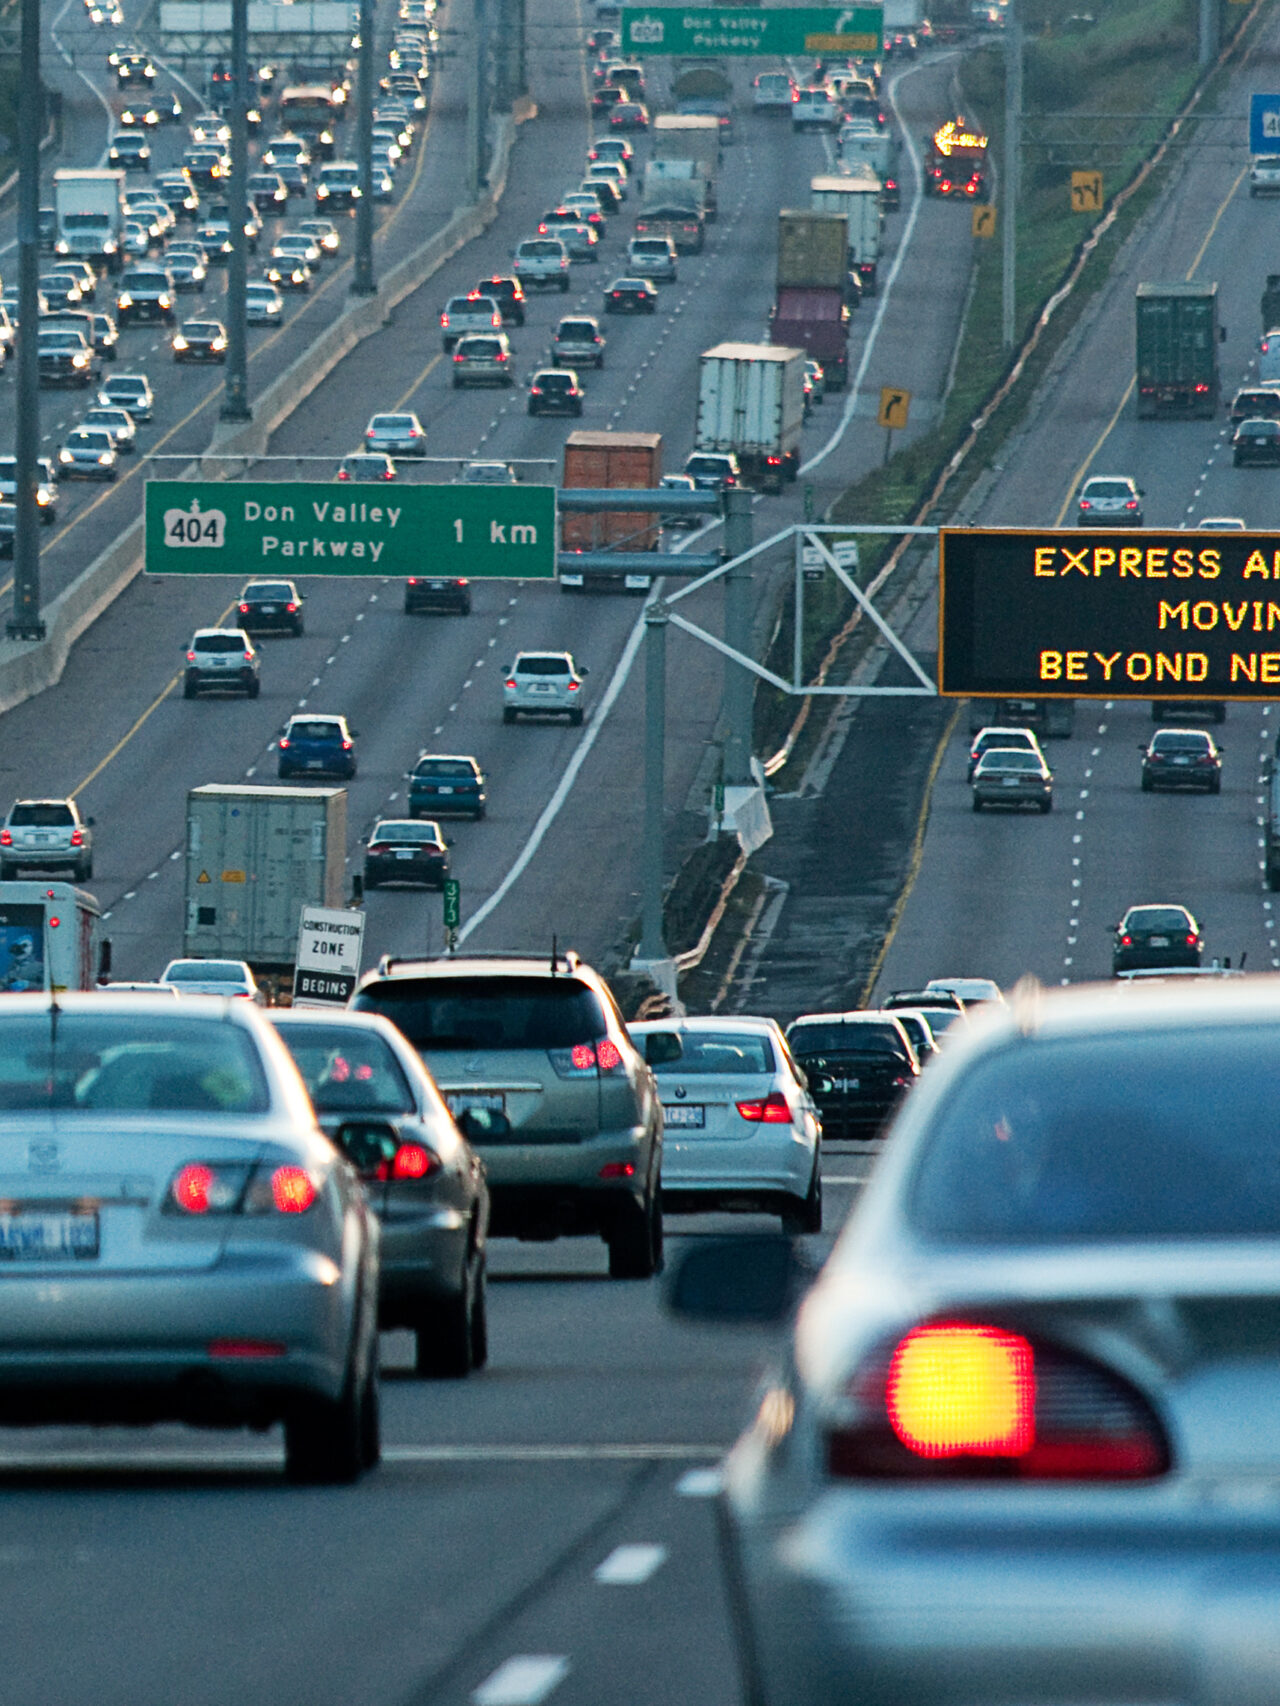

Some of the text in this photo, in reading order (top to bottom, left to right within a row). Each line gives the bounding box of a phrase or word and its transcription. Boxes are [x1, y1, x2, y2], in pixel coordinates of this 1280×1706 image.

[683, 17, 767, 32] Don Valley
[693, 34, 760, 48] Parkway
[244, 502, 402, 527] Don Valley
[169, 517, 218, 543] 404
[453, 519, 538, 544] 1 km
[262, 537, 385, 562] Parkway
[1034, 547, 1280, 580] EXPRESS A
[1039, 650, 1209, 682] BEYOND
[303, 919, 360, 936] CONSTRUCTION
[312, 941, 345, 957] ZONE
[301, 978, 348, 996] BEGINS
